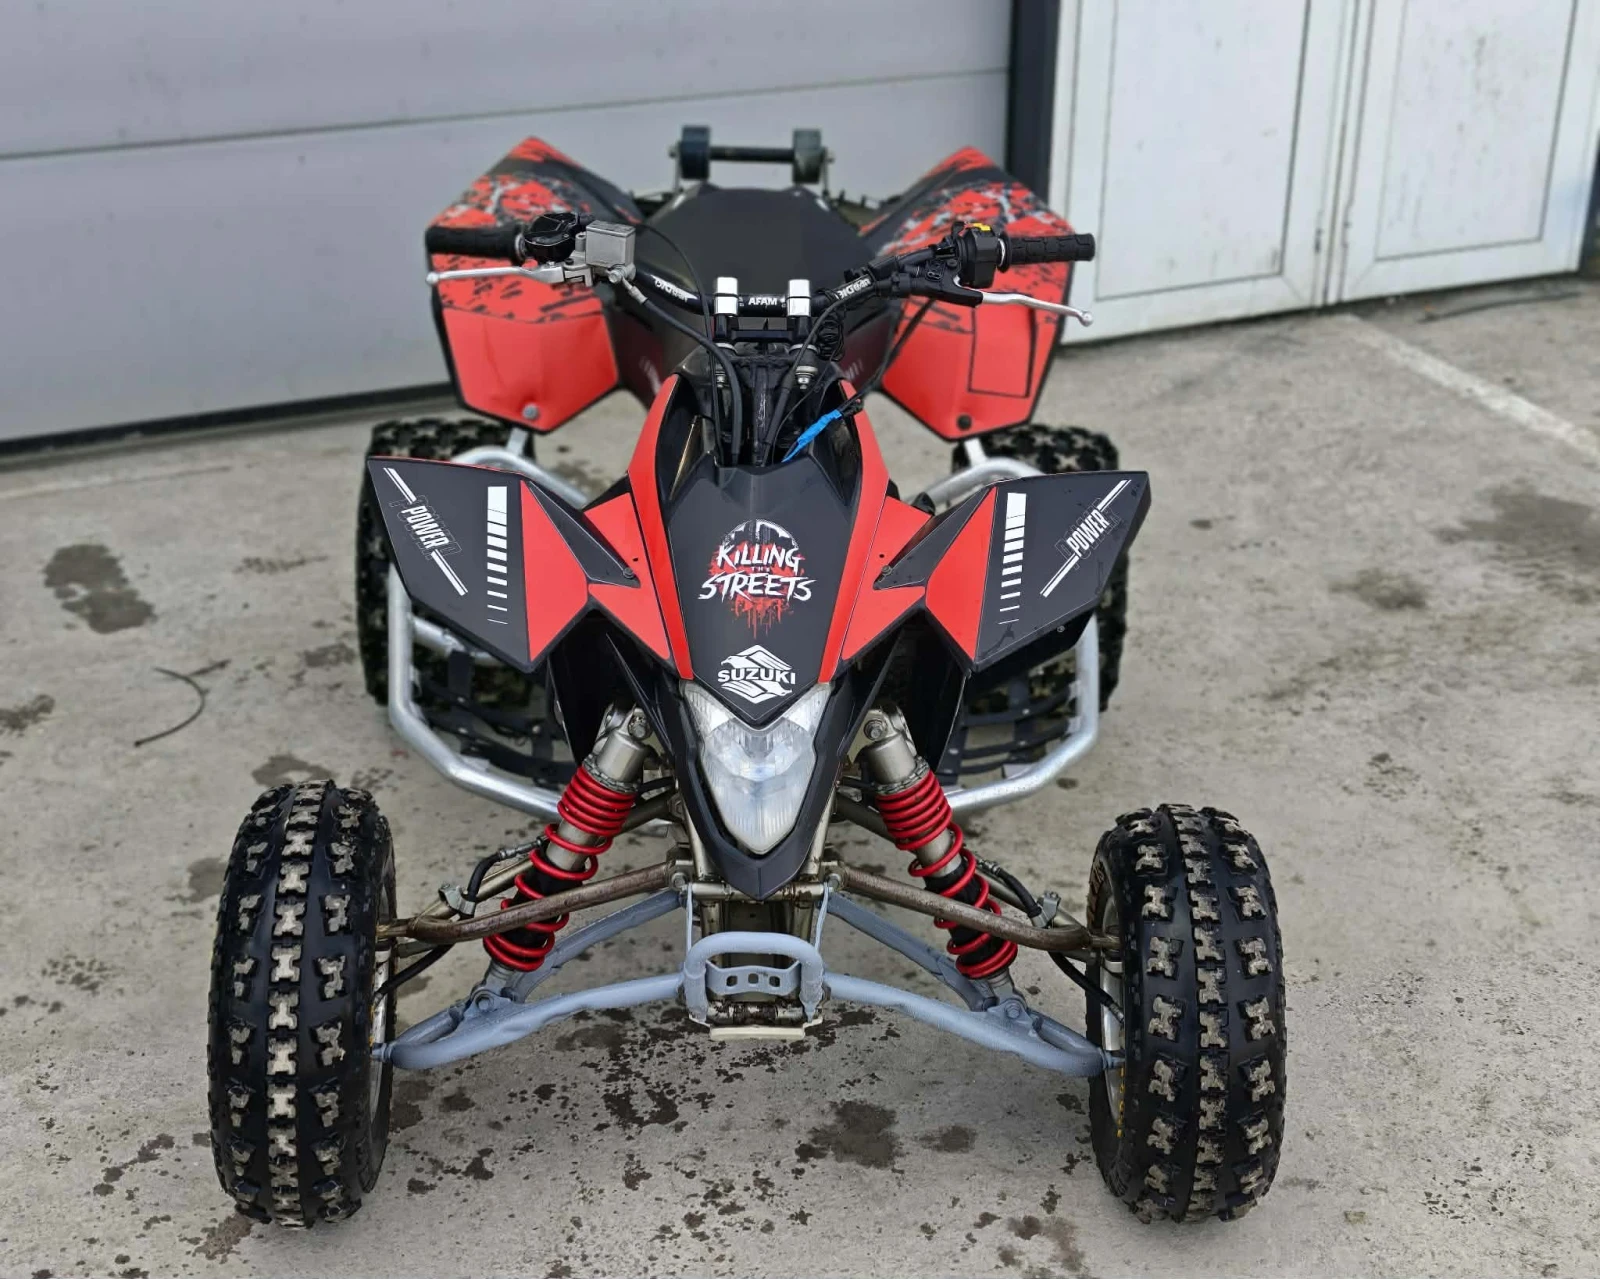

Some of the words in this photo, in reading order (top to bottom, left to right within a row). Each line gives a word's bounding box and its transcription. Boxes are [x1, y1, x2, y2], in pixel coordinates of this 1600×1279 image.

[748, 296, 778, 306] AFAM
[401, 505, 450, 549] POWER
[1066, 509, 1110, 557] POWER
[716, 543, 803, 576] KILLING
[698, 571, 817, 602] STREETS
[717, 668, 796, 685] SUZUKI
